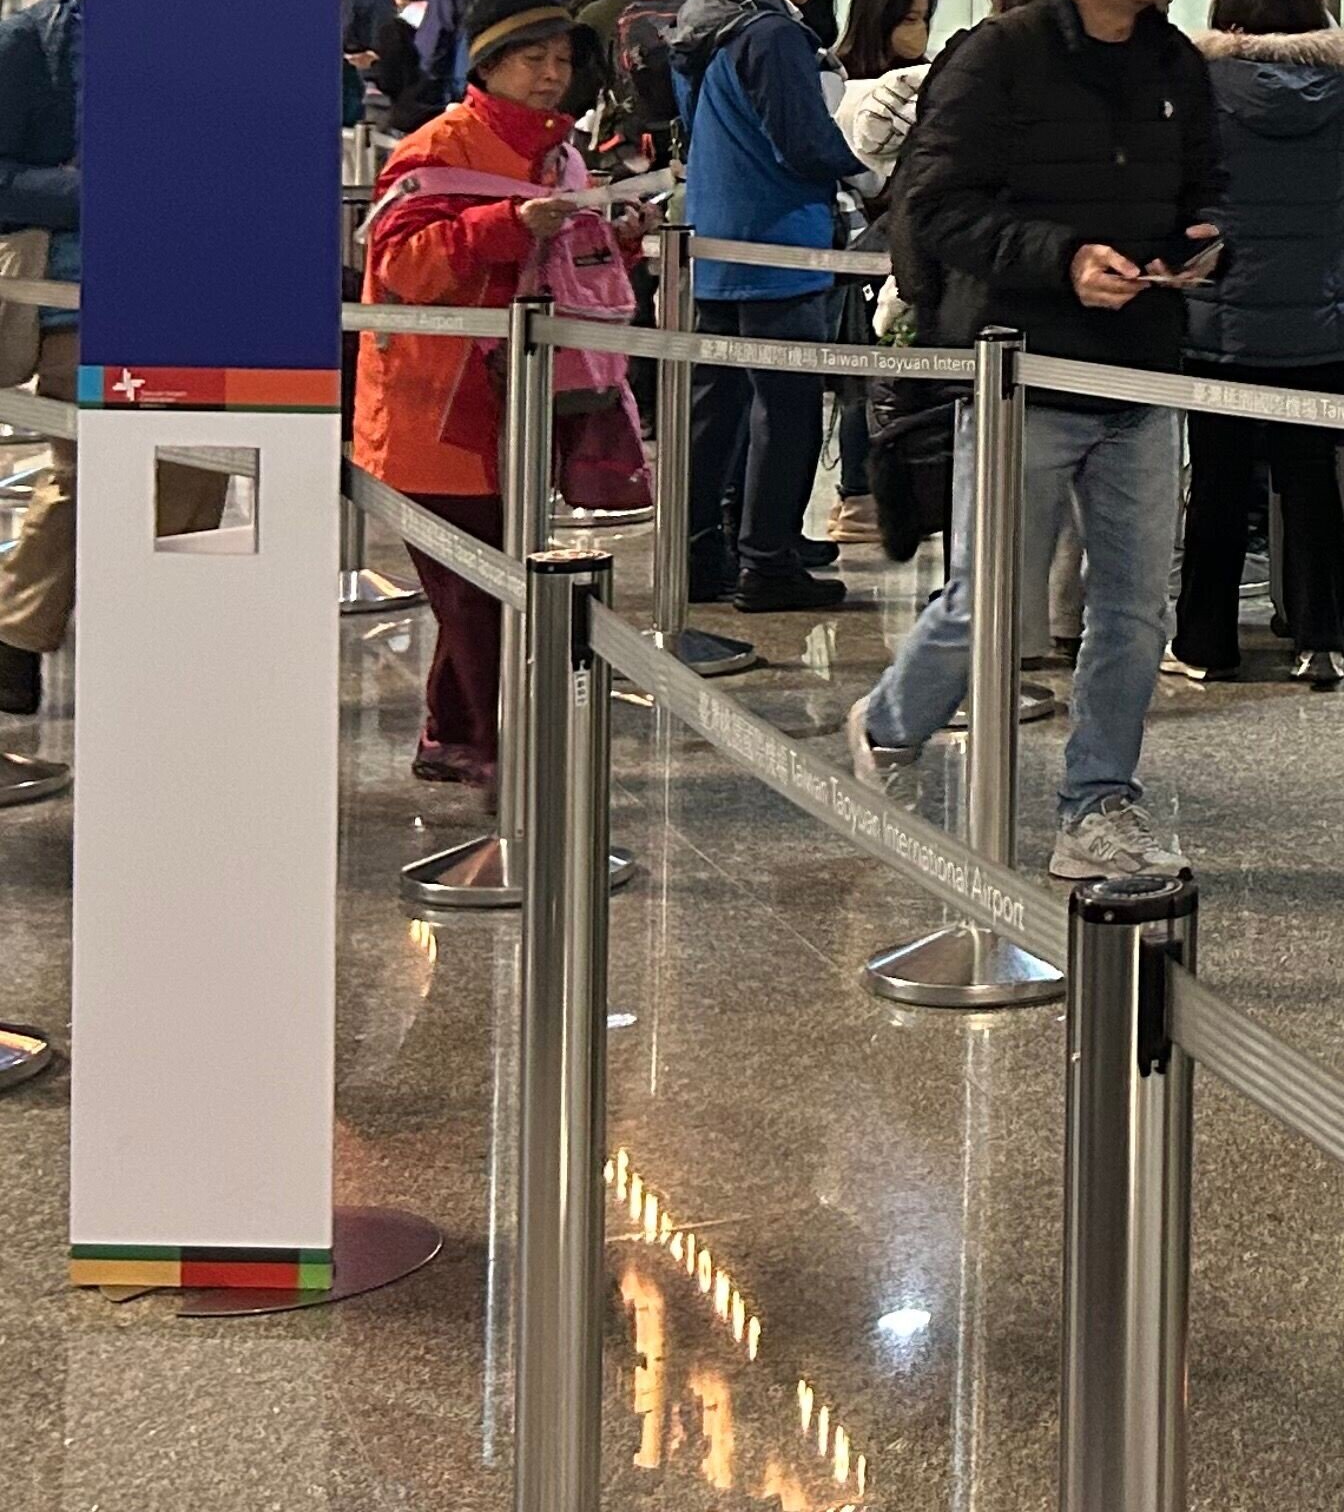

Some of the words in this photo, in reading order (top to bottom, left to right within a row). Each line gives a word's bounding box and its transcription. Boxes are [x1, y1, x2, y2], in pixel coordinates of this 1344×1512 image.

[821, 347, 869, 369] Taiwan
[871, 350, 931, 375] Taoyuan
[829, 776, 882, 837] Taoyuan
[884, 810, 970, 894] International
[968, 869, 1026, 933] Airport
